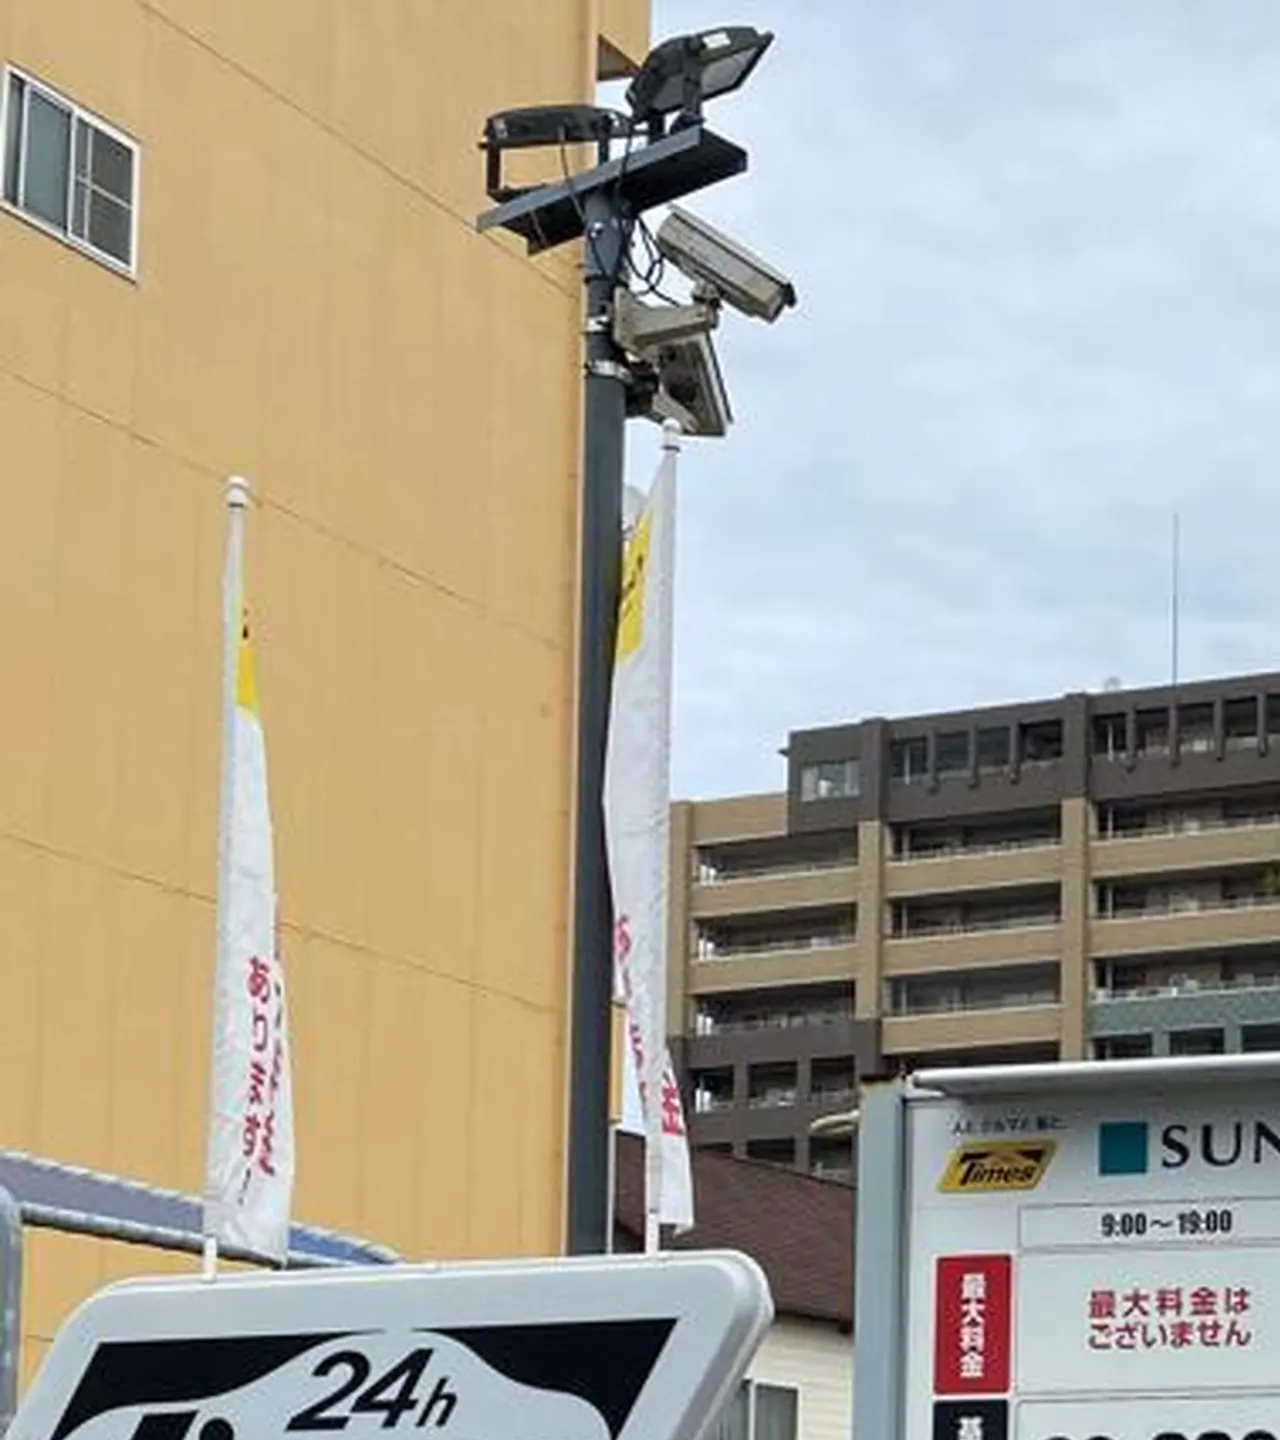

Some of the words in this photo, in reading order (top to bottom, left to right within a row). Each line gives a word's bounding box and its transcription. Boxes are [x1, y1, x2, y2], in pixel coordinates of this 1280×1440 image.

[959, 1272, 986, 1379] 最大料金
[1088, 1287, 1251, 1319] 最大料金は
[1088, 1320, 1252, 1351] ございません
[286, 1349, 458, 1432] 24h
